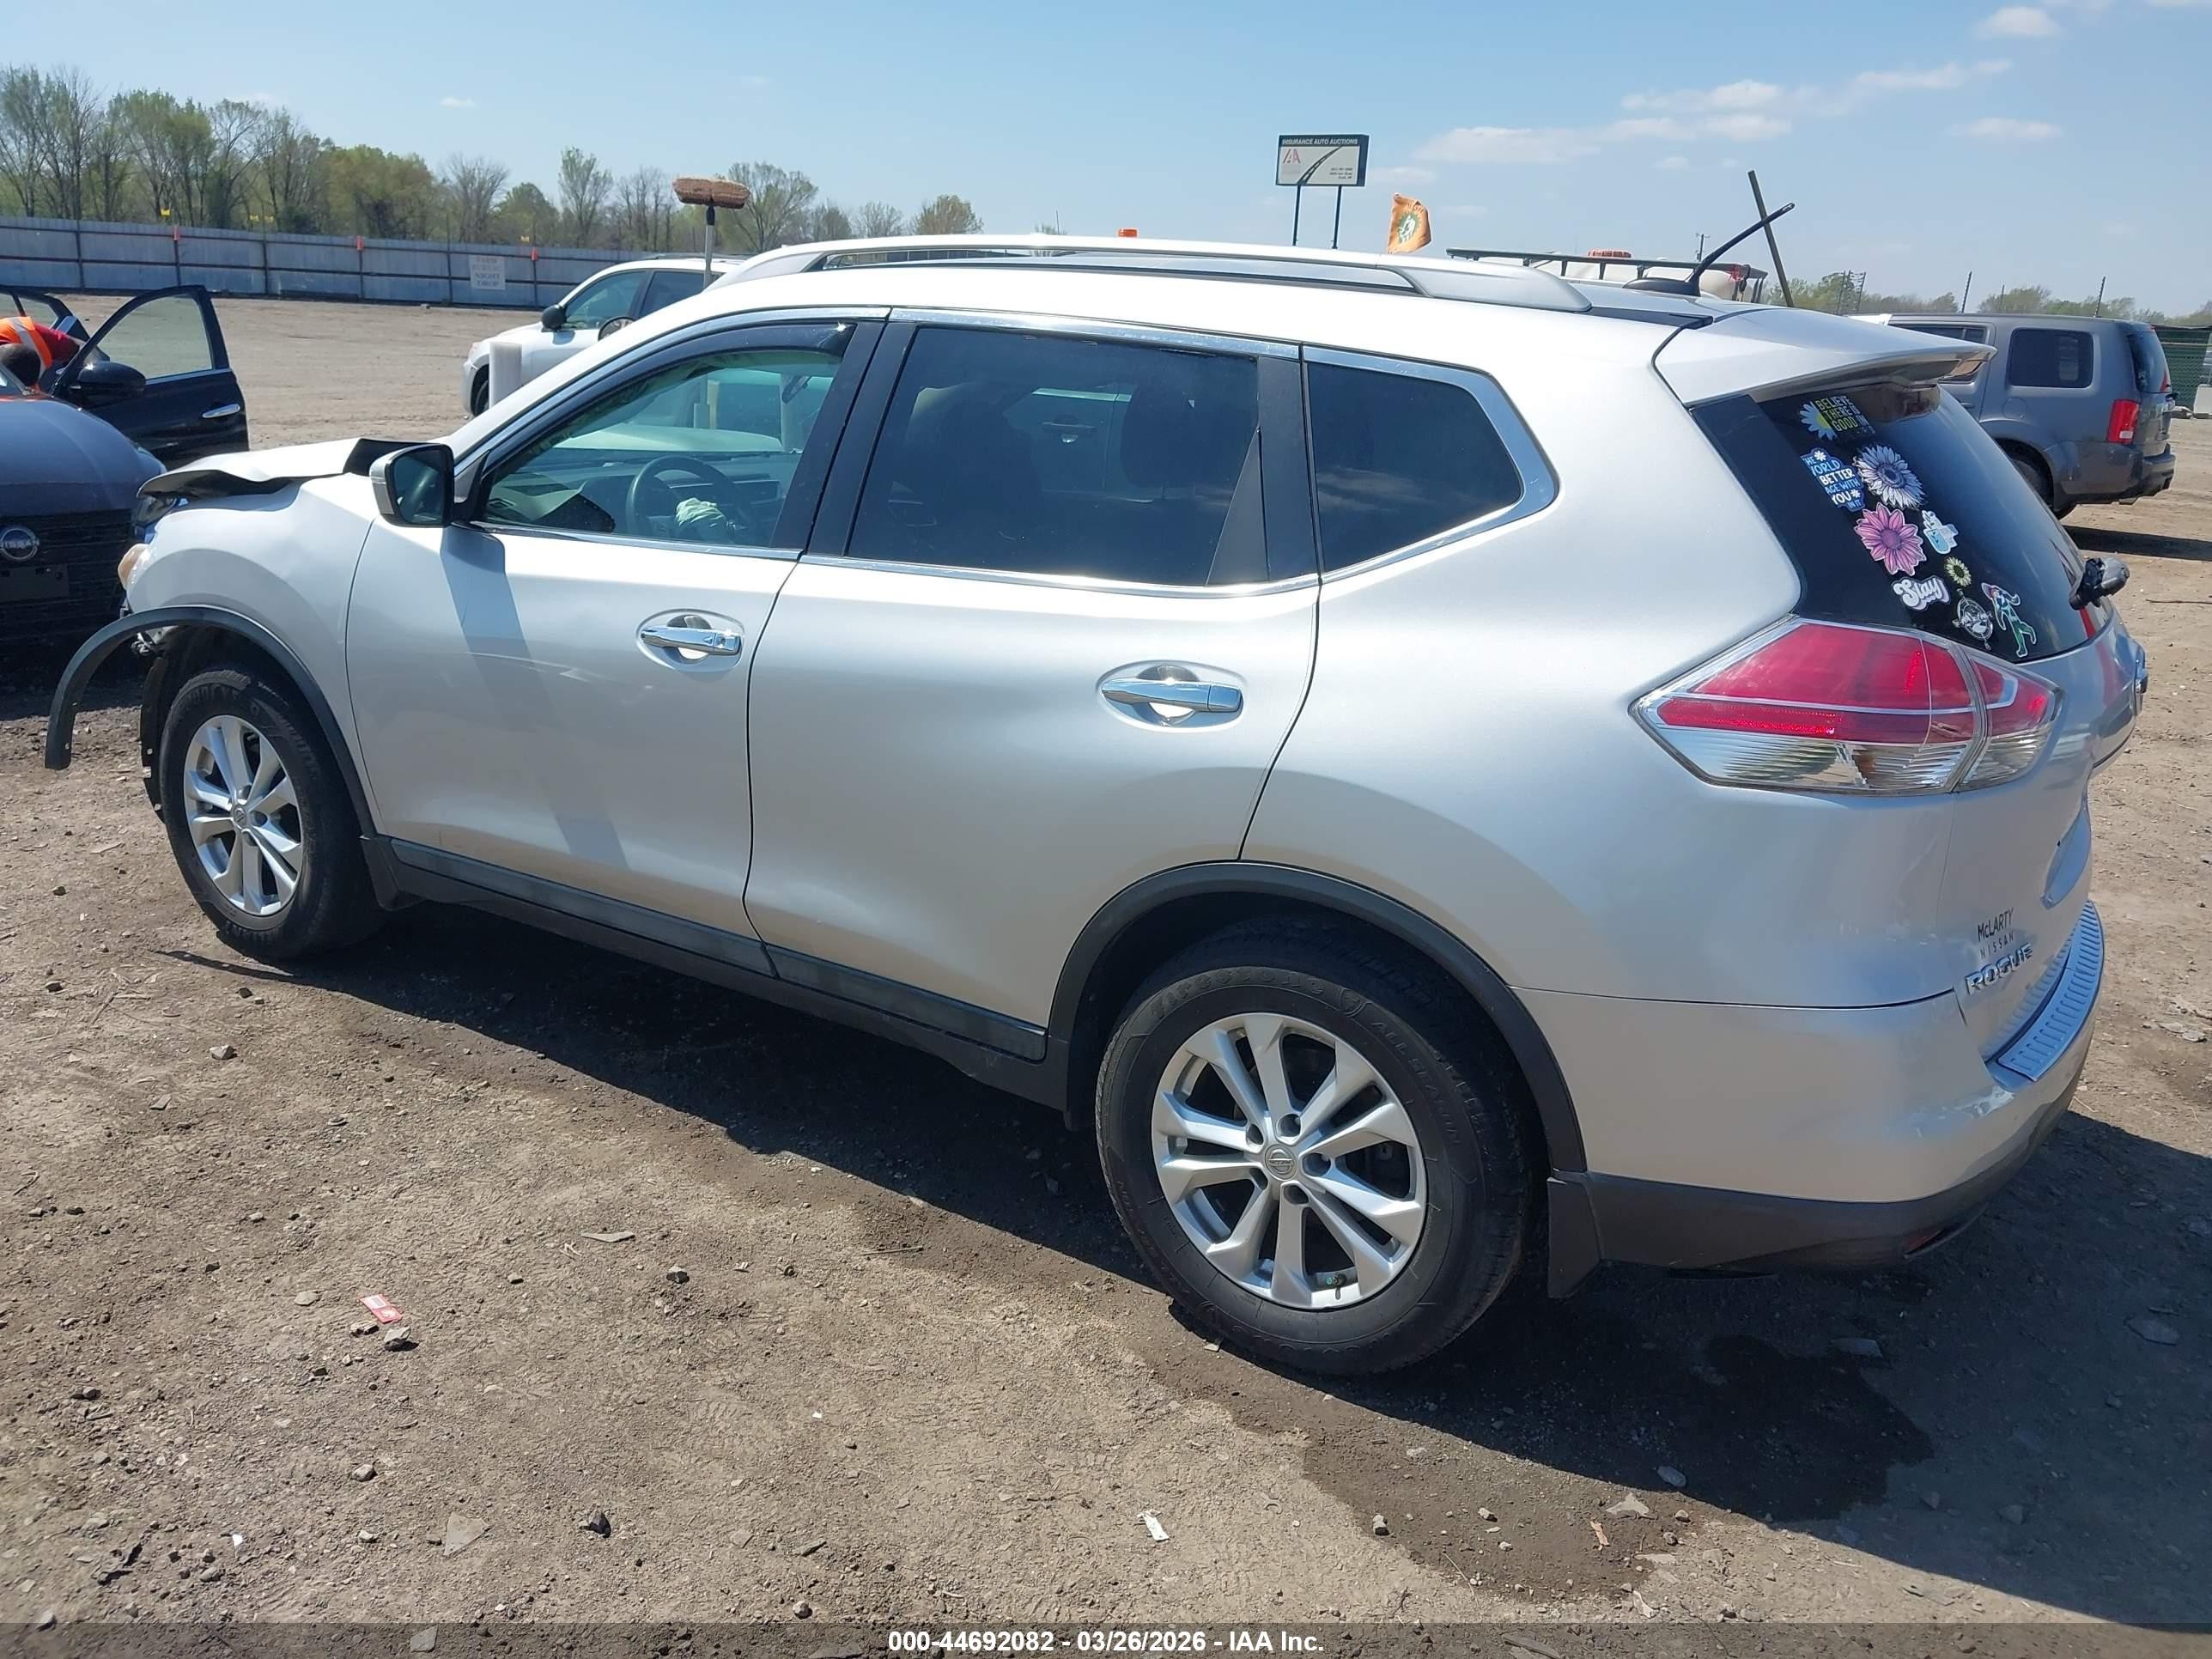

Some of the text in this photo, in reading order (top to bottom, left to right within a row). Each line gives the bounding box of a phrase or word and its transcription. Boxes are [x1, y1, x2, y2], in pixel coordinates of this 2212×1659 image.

[1814, 395, 1855, 410] BELIEVE
[1822, 405, 1853, 421] THERE
[1832, 416, 1858, 432] GOOD
[1819, 468, 1856, 486] BETTER
[1839, 477, 1861, 490] WITH
[1832, 490, 1852, 505] YOU
[1977, 908, 2014, 942] McLARTY
[1980, 931, 2014, 959] NISSAN
[1965, 942, 2034, 996] ROGUE
